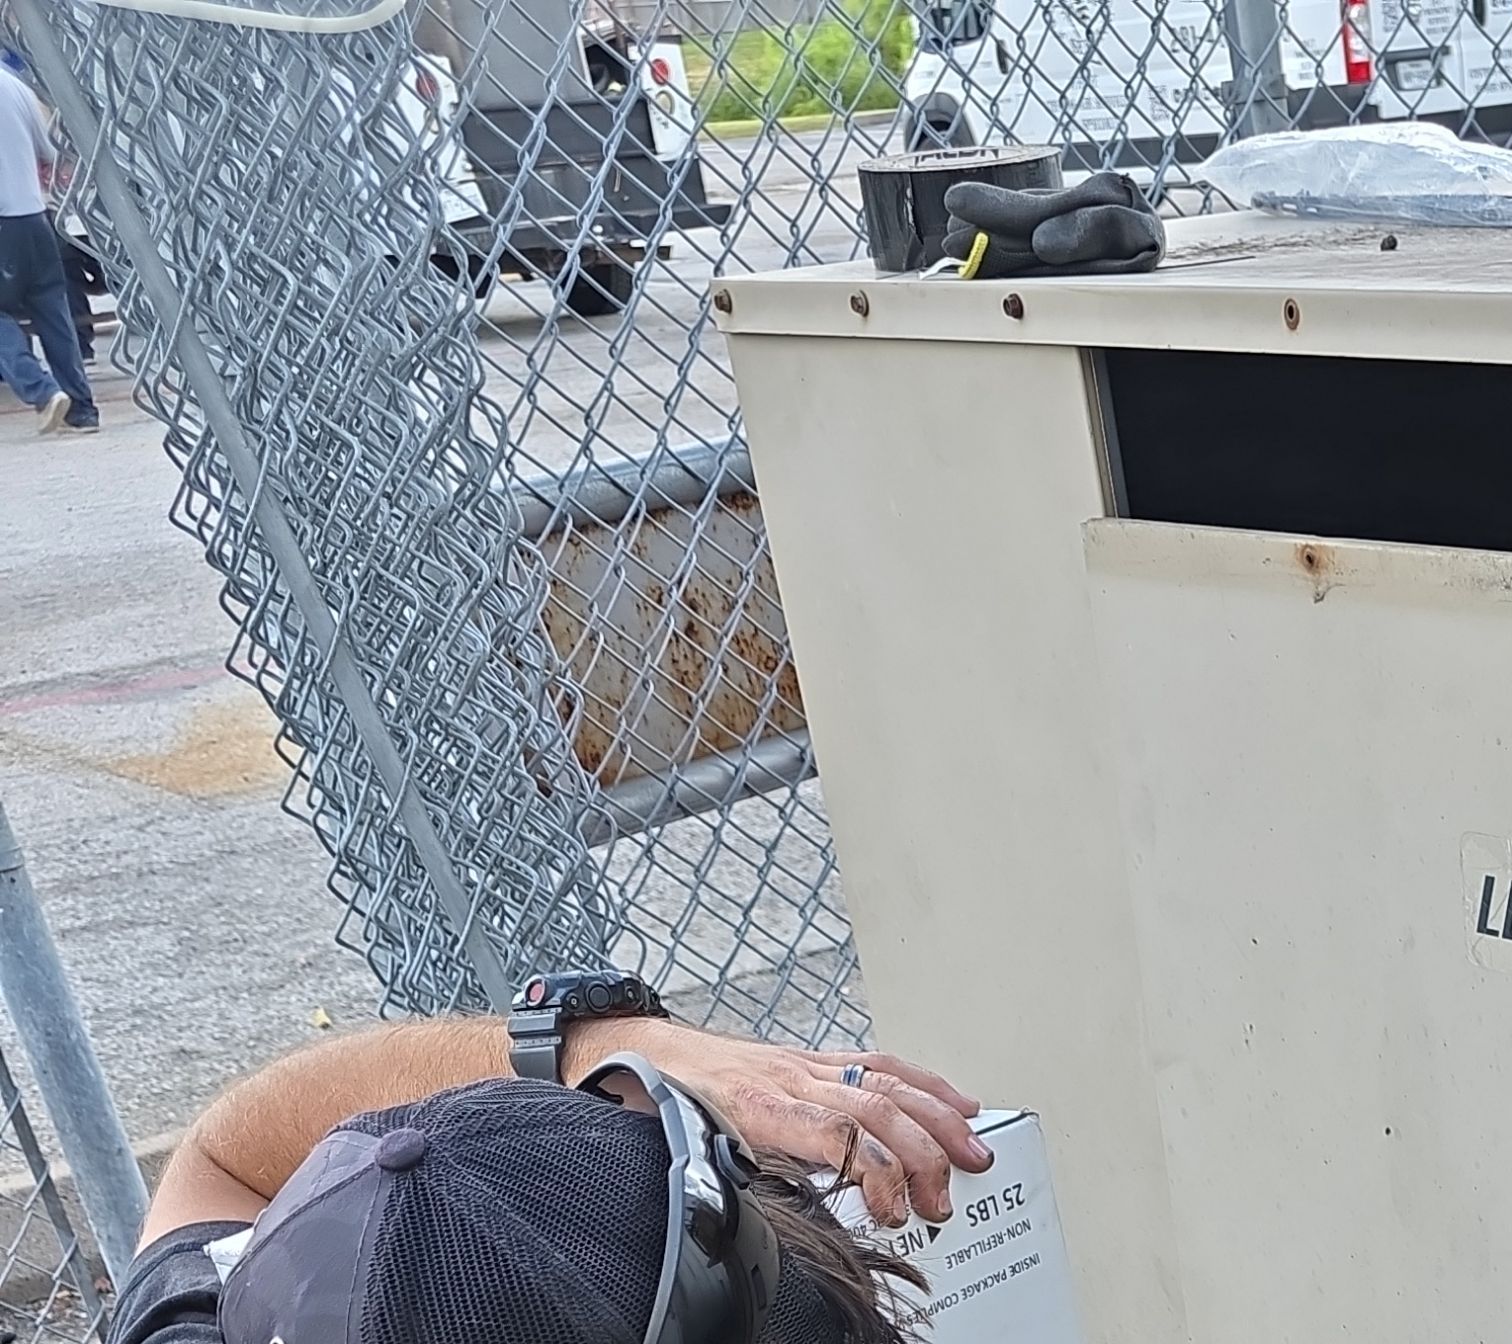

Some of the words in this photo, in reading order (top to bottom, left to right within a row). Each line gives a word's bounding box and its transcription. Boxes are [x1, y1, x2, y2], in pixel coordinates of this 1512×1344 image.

[966, 1195, 999, 1227] LBS
[1003, 1183, 1025, 1210] 25
[884, 1226, 927, 1262] NET
[945, 1219, 1031, 1269] NON-REFILLABLE
[1009, 1253, 1040, 1277] INSIDE
[961, 1269, 1007, 1300] PACKAGE
